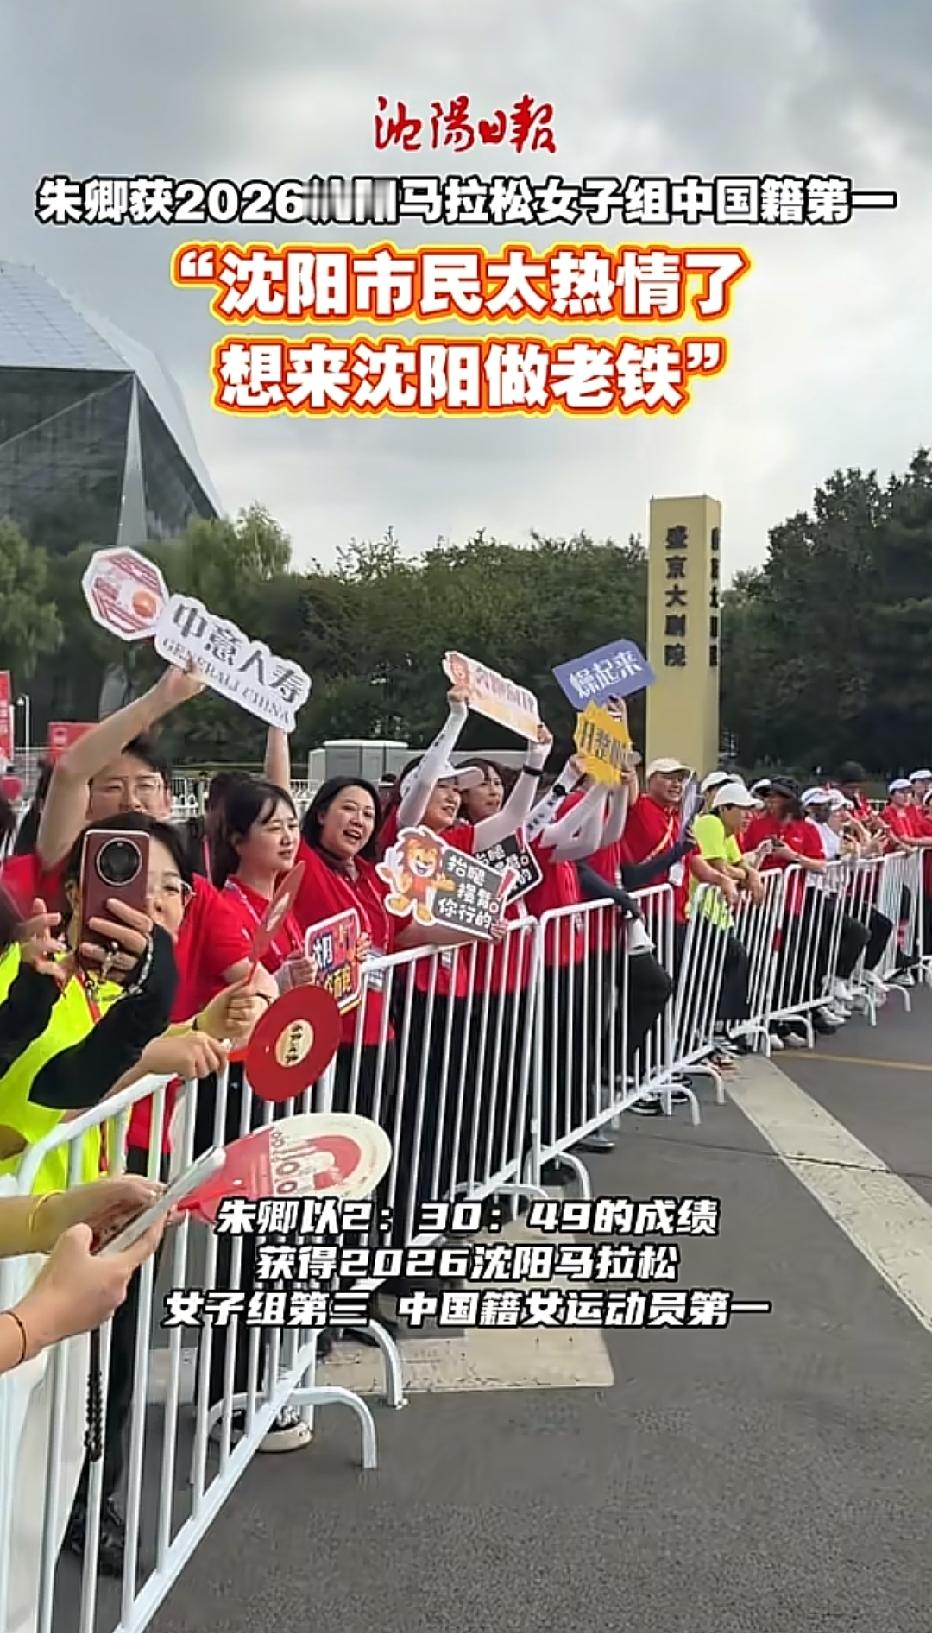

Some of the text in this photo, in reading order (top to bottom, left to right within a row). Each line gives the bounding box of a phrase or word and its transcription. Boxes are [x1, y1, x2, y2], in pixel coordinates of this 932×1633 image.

[172, 603, 305, 704] 中意人寿
[241, 686, 290, 725] CHINA
[437, 897, 493, 929] 你行的
